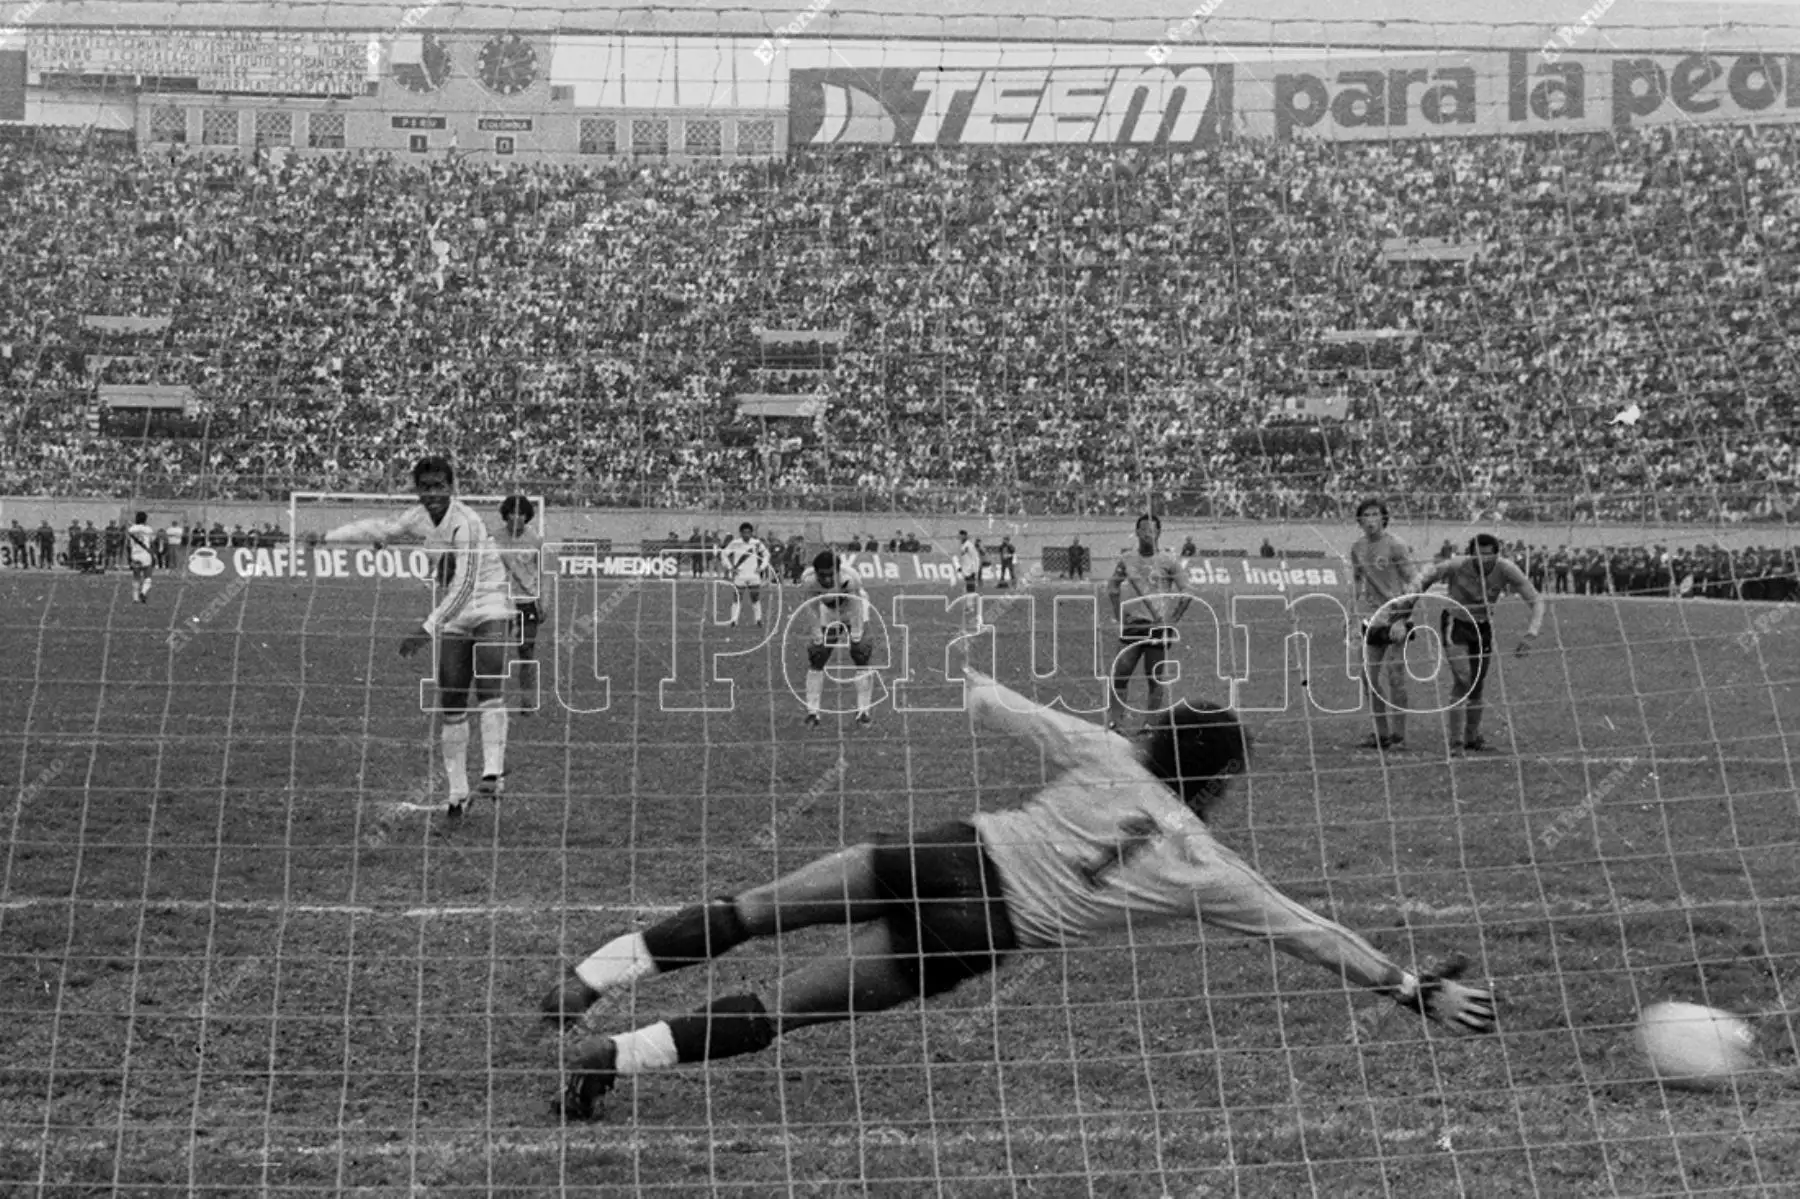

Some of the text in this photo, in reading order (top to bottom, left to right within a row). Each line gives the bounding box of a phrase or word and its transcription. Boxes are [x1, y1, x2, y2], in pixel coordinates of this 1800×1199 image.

[1274, 66, 1476, 144] para
[1508, 50, 1586, 121] la
[313, 549, 349, 577] DE
[356, 549, 437, 578] COLO
[1181, 555, 1230, 584] ola
